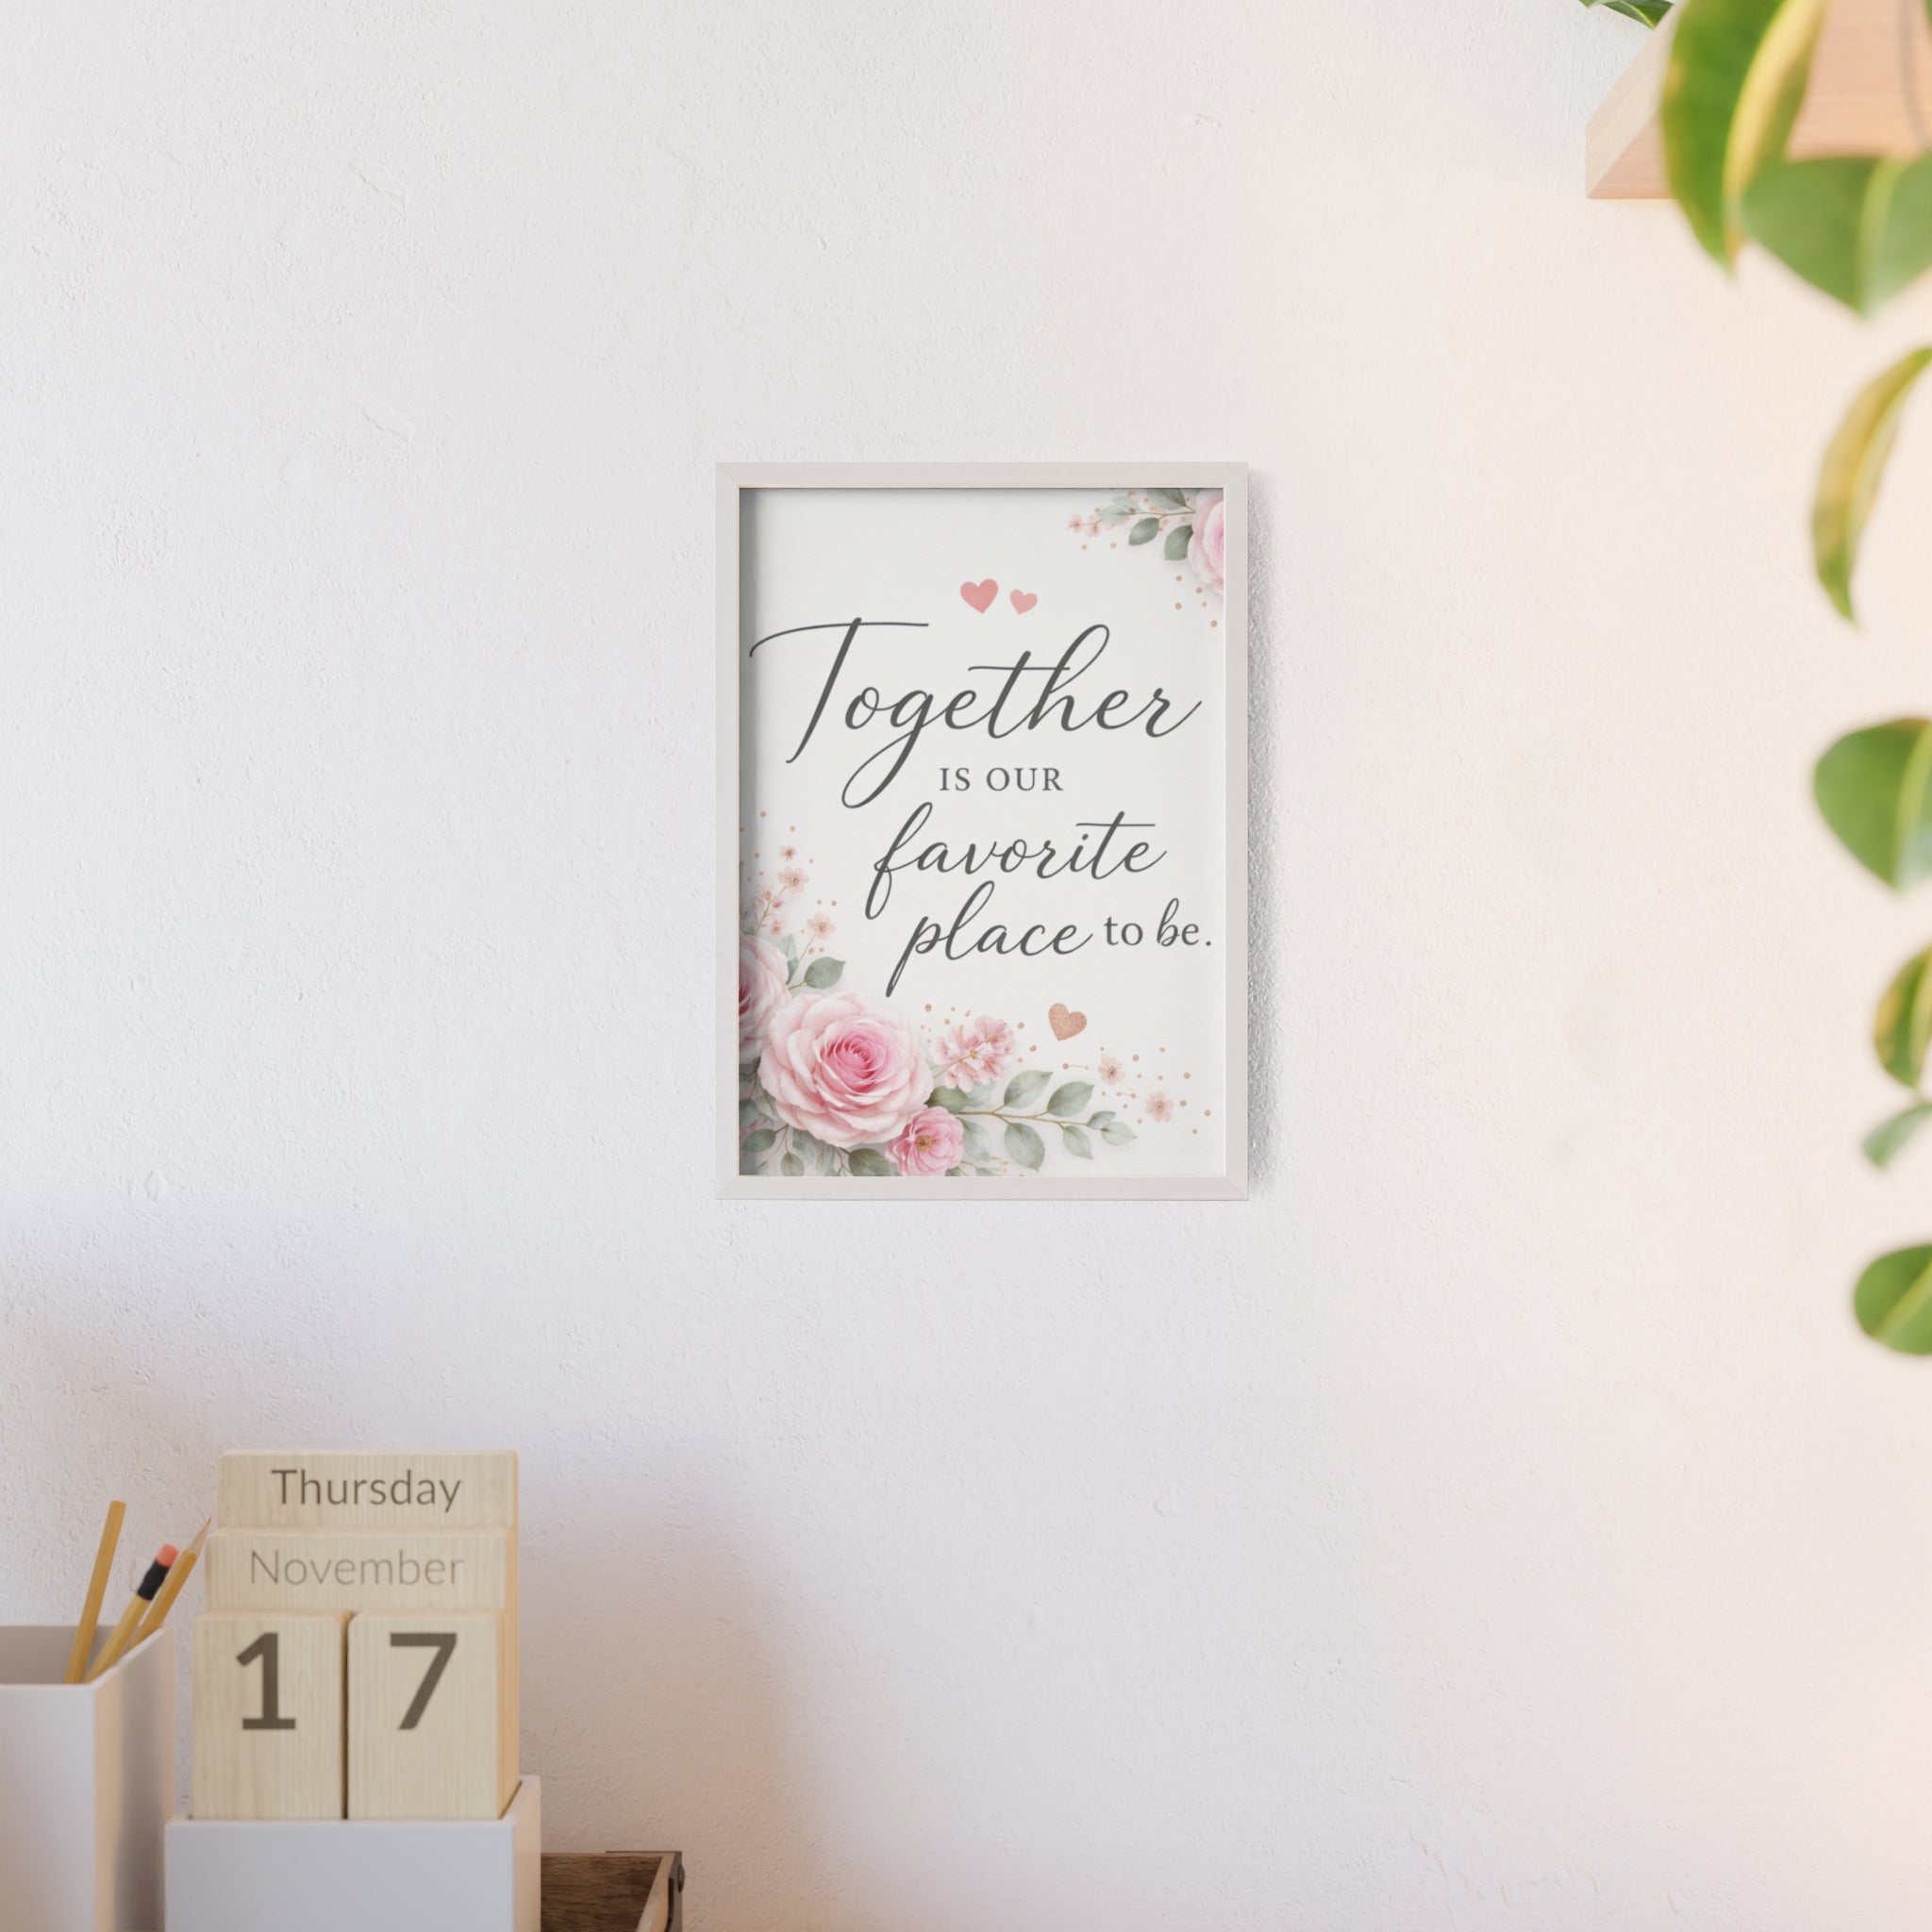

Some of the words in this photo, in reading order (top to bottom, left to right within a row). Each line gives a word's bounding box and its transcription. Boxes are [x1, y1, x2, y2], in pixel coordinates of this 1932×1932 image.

[750, 617, 1202, 808] Together
[940, 767, 970, 791] IS
[986, 767, 1064, 791] OUR
[864, 802, 1167, 919] favorite
[886, 881, 1093, 997] place
[1103, 916, 1143, 947] to
[1157, 898, 1213, 947] be.
[271, 1469, 461, 1512] Thursday
[250, 1550, 464, 1586] November
